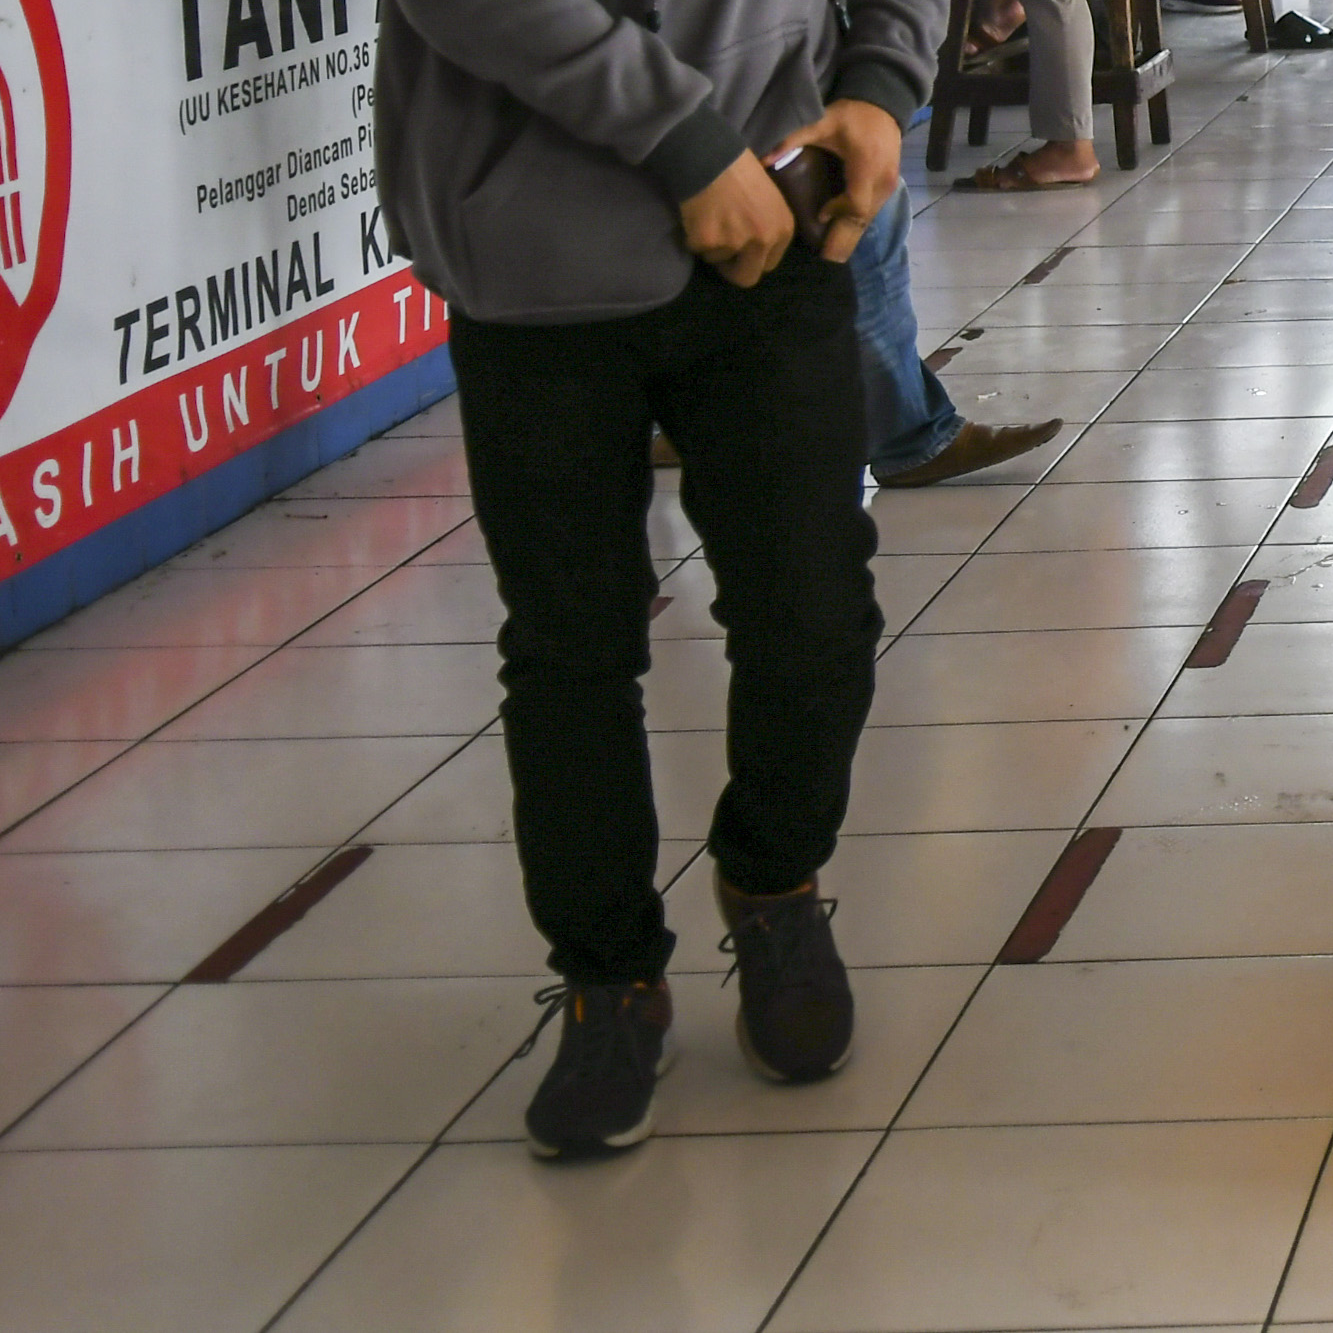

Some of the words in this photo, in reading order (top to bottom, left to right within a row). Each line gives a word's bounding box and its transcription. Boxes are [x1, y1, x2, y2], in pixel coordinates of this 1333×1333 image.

[178, 85, 211, 135] (UU
[218, 55, 321, 117] KESEHATAN
[325, 41, 371, 80] NO.36
[197, 161, 282, 215] Pelanggar
[288, 134, 354, 180] Diancam
[287, 184, 337, 223] Denda
[114, 231, 335, 386] TERMINAL
[179, 311, 361, 454] UNTUK
